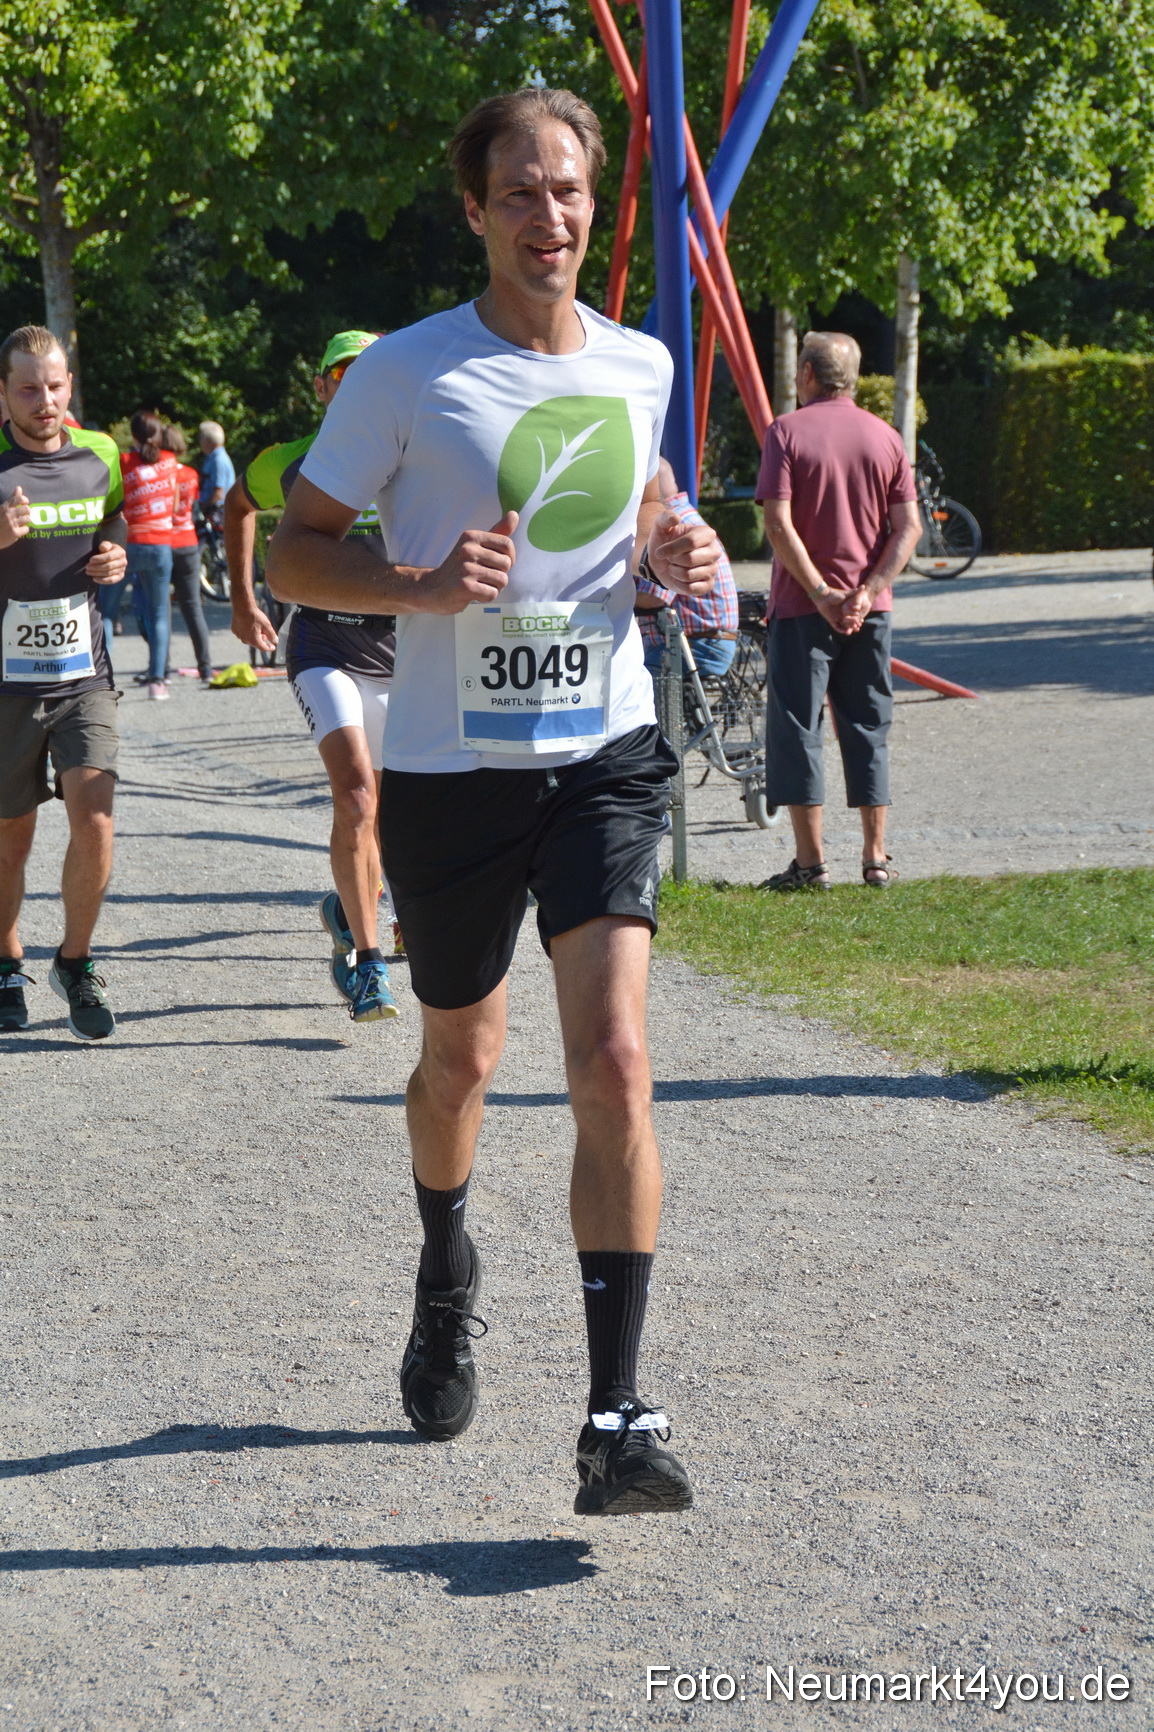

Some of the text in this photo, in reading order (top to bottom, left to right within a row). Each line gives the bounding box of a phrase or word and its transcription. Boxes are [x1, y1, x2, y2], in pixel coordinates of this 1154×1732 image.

[29, 497, 105, 528] OCK
[40, 530, 51, 539] by
[53, 527, 80, 537] smart
[29, 606, 68, 618] BOCK
[502, 616, 571, 632] BOCK
[16, 619, 79, 648] 2532
[33, 661, 68, 673] Arthur
[480, 643, 589, 690] 3049
[491, 696, 569, 707] PARTL Neumarkt
